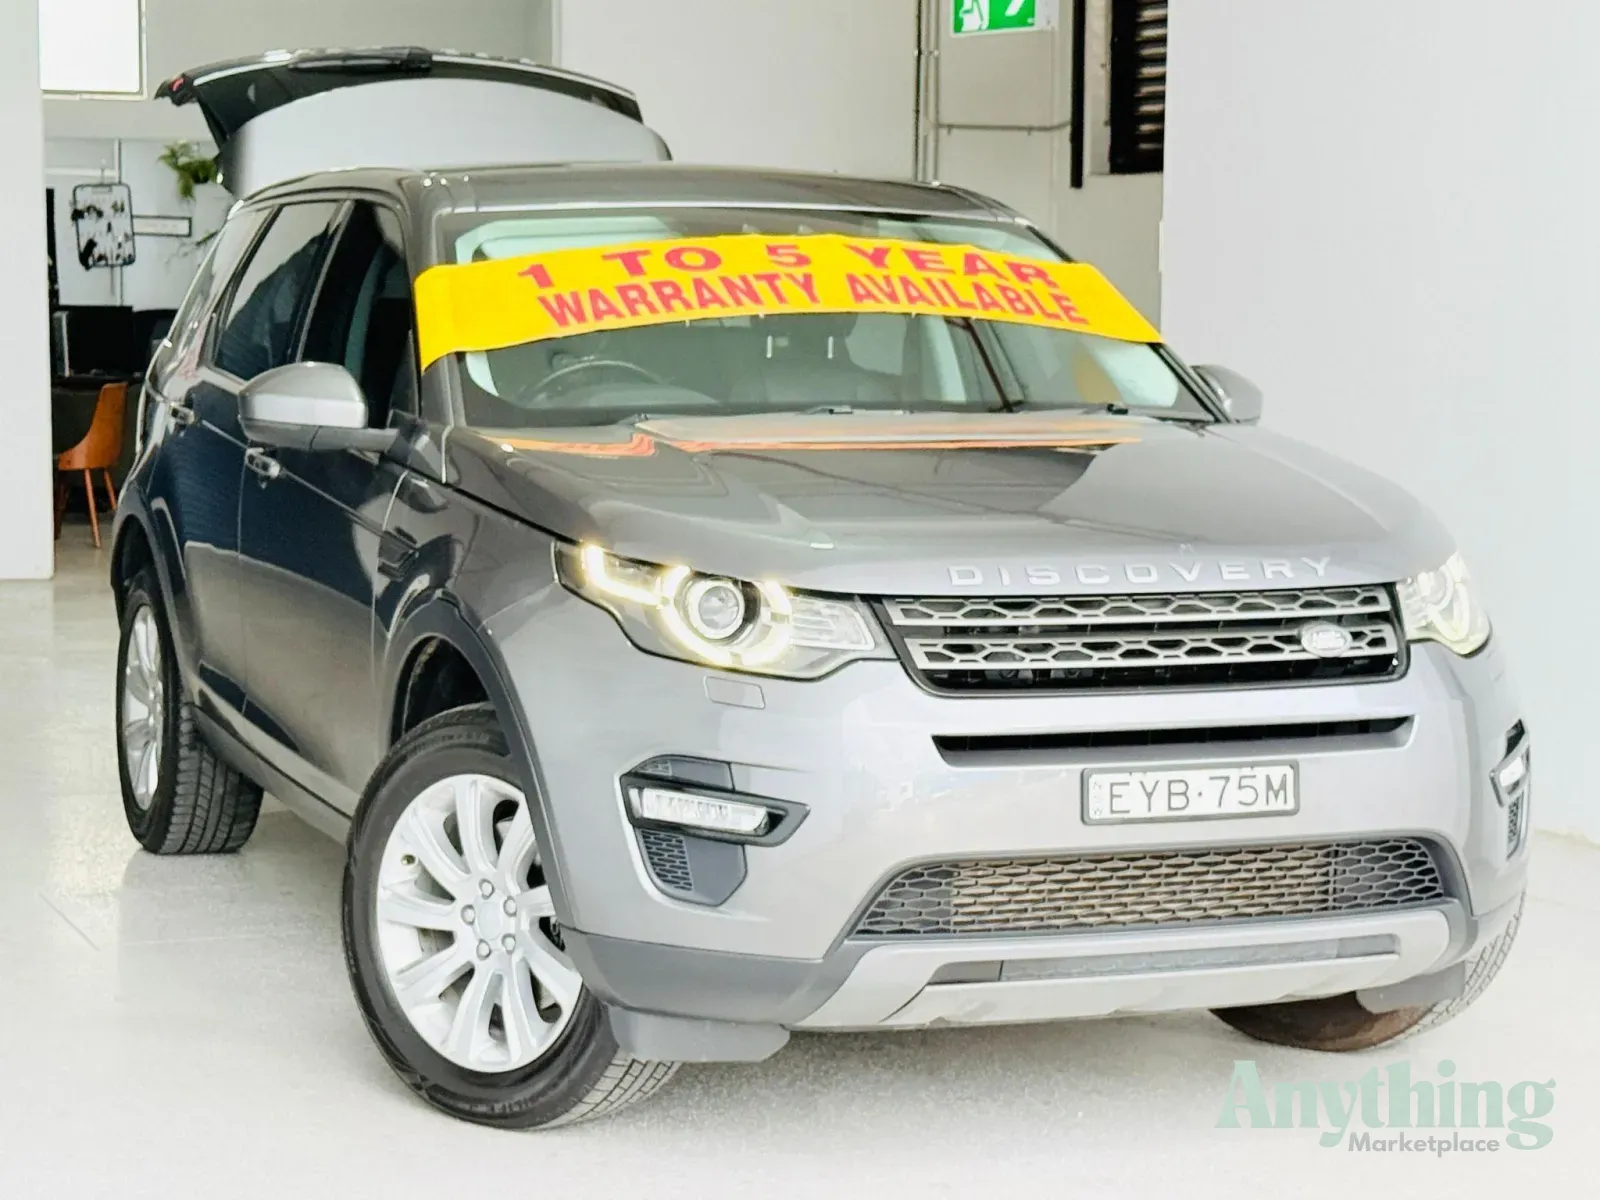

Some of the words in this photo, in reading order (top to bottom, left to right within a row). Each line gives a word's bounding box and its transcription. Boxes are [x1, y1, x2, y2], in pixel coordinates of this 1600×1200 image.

[518, 263, 554, 289] 1
[602, 246, 722, 277] TO
[765, 243, 812, 268] 5
[842, 243, 1060, 289] YEAR
[537, 272, 820, 327] WARRANTY
[846, 272, 1090, 325] AVAILABLE
[948, 556, 1332, 587] DISCOVERY
